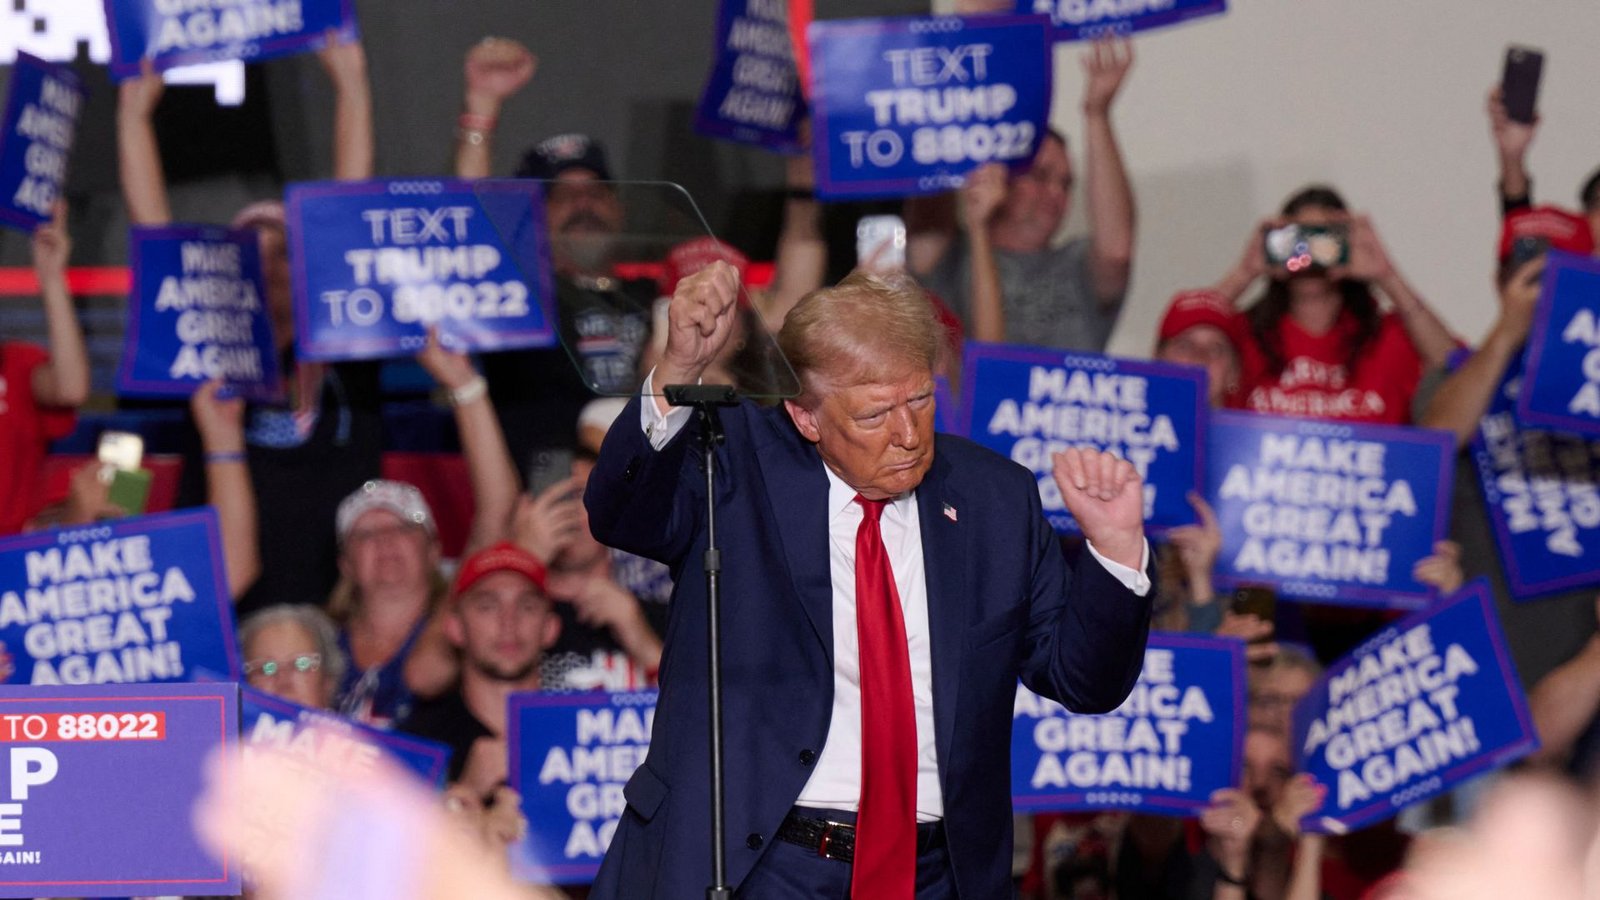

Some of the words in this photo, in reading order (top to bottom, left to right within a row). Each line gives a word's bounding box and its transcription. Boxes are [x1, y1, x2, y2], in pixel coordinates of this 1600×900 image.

[158, 3, 303, 52] AGAIN!
[884, 43, 993, 86] TEXT
[866, 83, 1017, 127] TRUMP
[841, 130, 905, 169] TO
[912, 121, 1036, 165] 88022
[362, 206, 474, 245] TEXT
[345, 244, 501, 286] TRUMP
[320, 287, 384, 327] TO
[391, 280, 530, 325] 88022
[1029, 366, 1148, 411] MAKE
[988, 399, 1179, 450] AMERICA
[1261, 433, 1386, 477] MAKE
[1218, 464, 1417, 516] AMERICA
[1242, 502, 1391, 546] GREAT
[25, 535, 153, 587] MAKE
[1234, 537, 1390, 584] AGAIN!
[0, 566, 196, 629] AMERICA
[24, 606, 173, 660] GREAT
[31, 641, 184, 685] AGAIN!
[1328, 622, 1434, 705] MAKE
[1304, 643, 1479, 755] AMERICA
[4, 715, 48, 740] TO
[57, 713, 158, 739] 88022
[1033, 716, 1189, 755] GREAT
[1325, 684, 1459, 770] GREAT
[1031, 751, 1192, 792] AGAIN!
[1337, 716, 1481, 810] AGAIN!
[0, 851, 41, 864] AIN!
